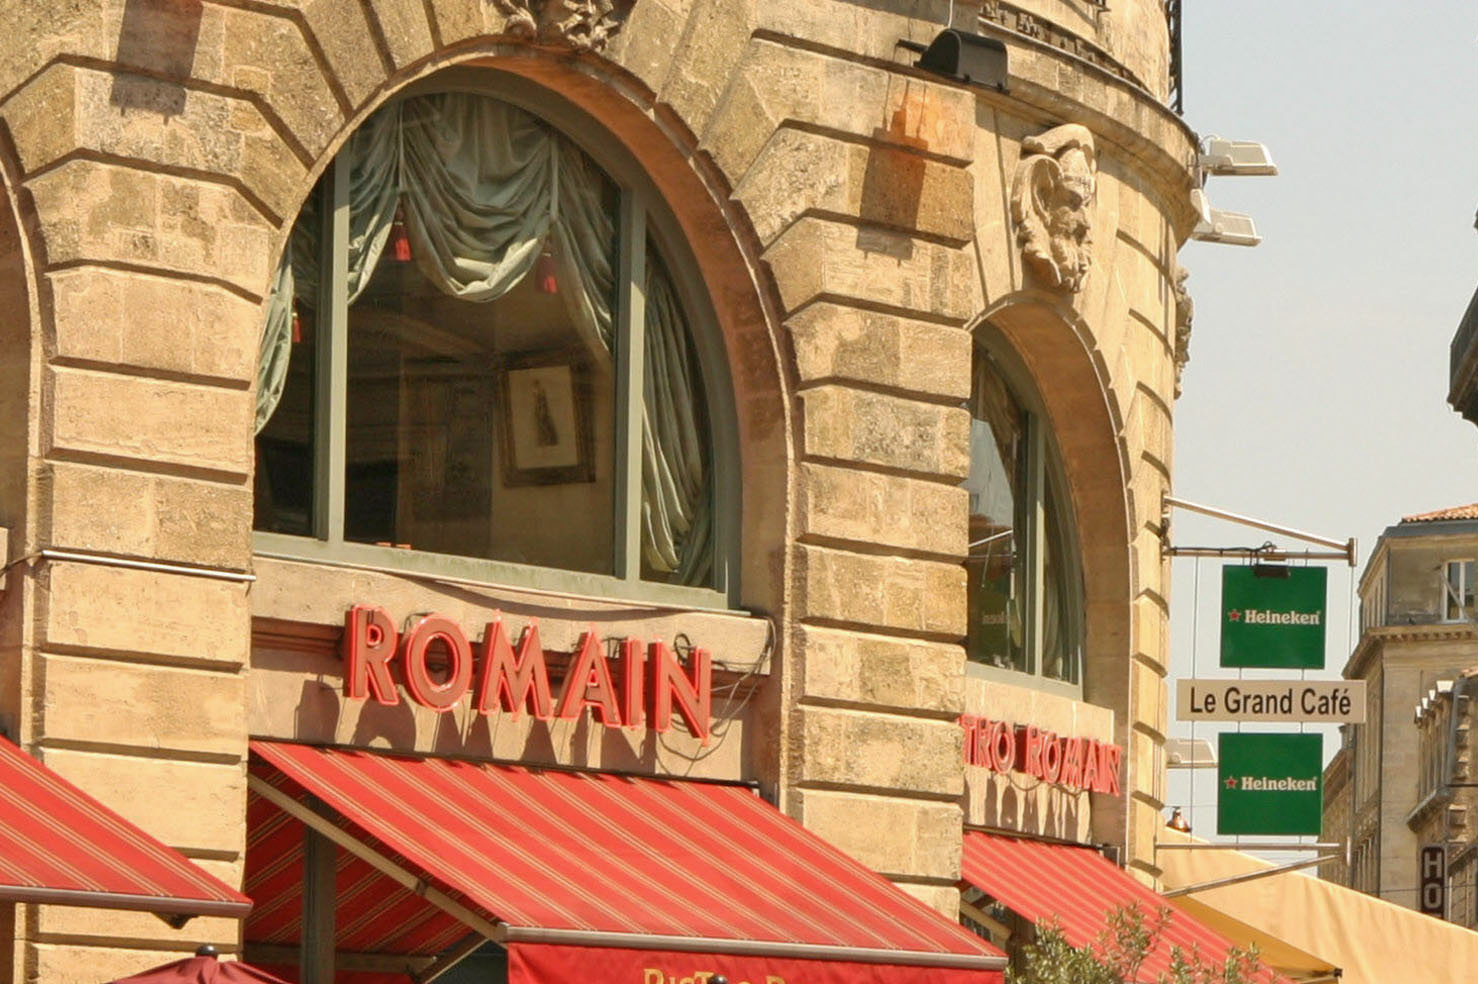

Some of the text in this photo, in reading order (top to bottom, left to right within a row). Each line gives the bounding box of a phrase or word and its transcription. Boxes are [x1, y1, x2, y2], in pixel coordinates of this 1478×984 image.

[1244, 609, 1321, 625] Heineken
[344, 604, 712, 746] ROMAIN
[1190, 686, 1351, 715] Le Grand Café
[1026, 724, 1122, 797] ROMAIN
[1241, 775, 1318, 791] Heineken
